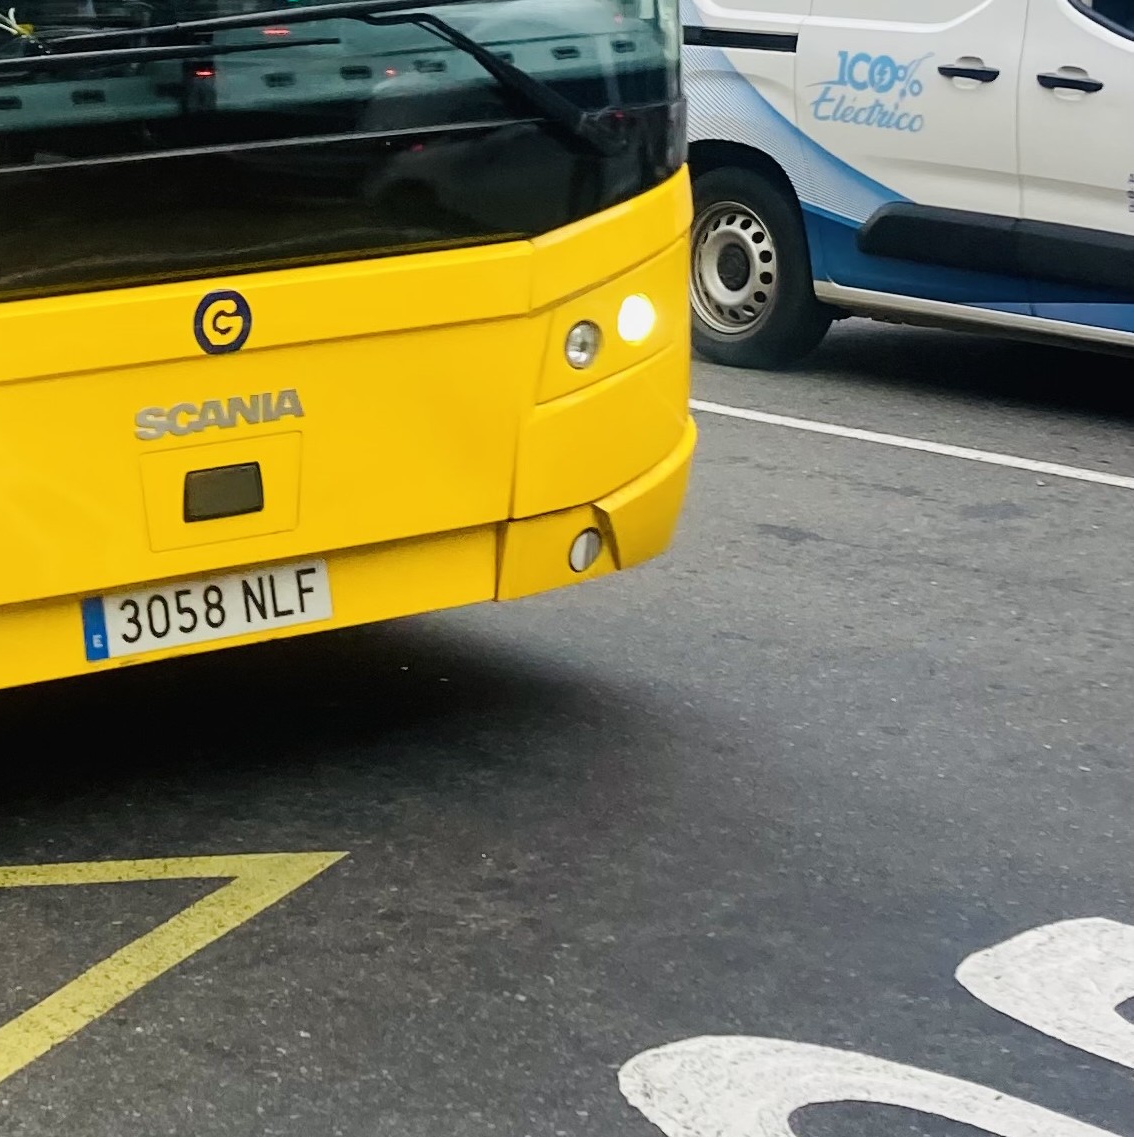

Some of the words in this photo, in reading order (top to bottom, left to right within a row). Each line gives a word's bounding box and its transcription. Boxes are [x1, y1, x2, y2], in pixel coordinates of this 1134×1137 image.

[833, 50, 930, 97] 100%
[810, 86, 924, 133] Eléctrico
[135, 389, 305, 441] SCANIA
[92, 634, 104, 649] E
[119, 585, 226, 643] 3058
[241, 567, 316, 623] NLF
